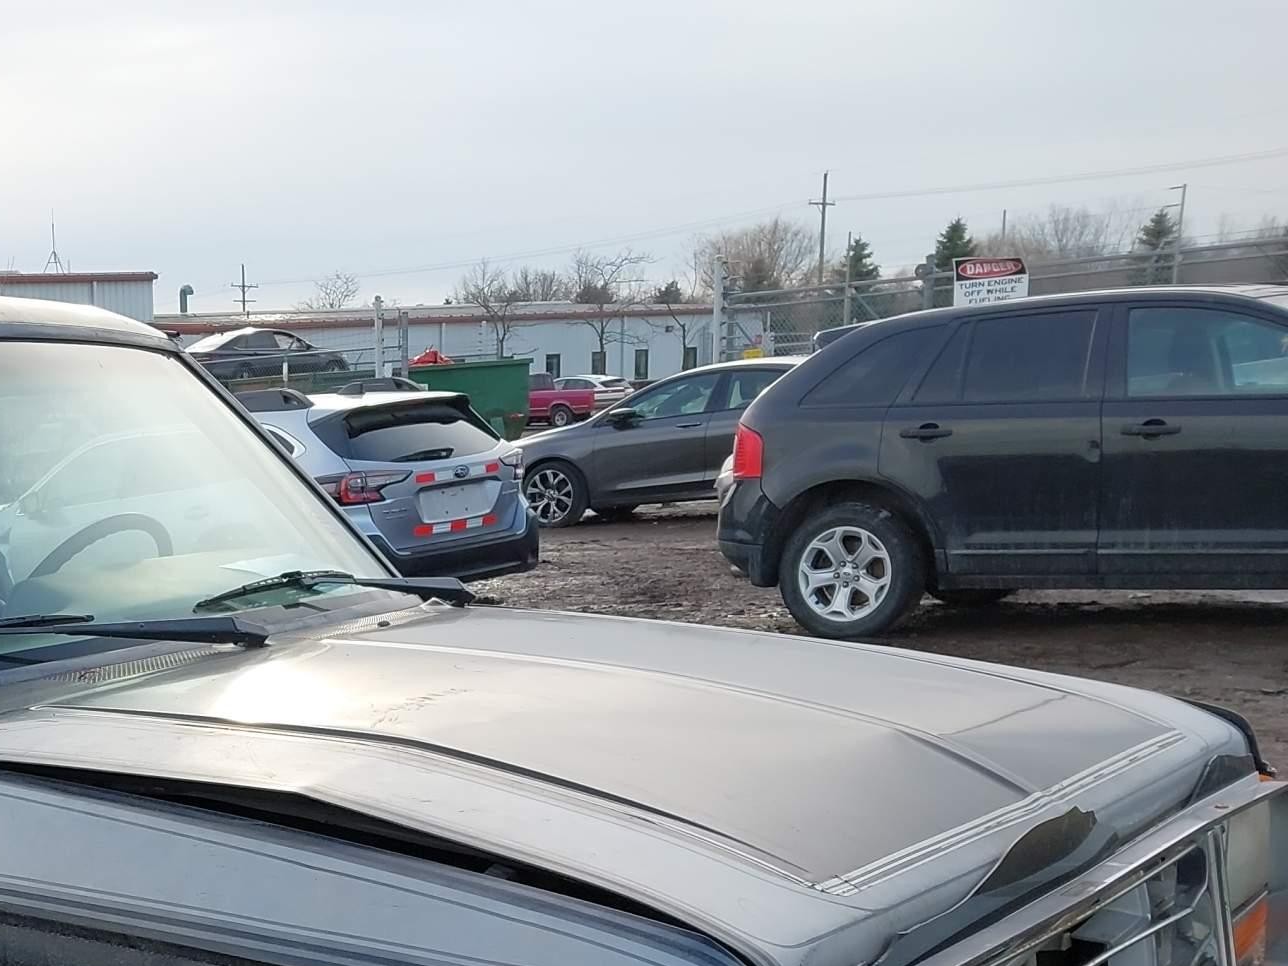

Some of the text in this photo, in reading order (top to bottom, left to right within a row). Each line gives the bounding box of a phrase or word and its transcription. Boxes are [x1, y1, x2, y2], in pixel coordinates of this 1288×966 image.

[966, 261, 1016, 275] DANGER
[959, 276, 1024, 290] TURN ENGINE
[963, 286, 1017, 298] OFF WHILE
